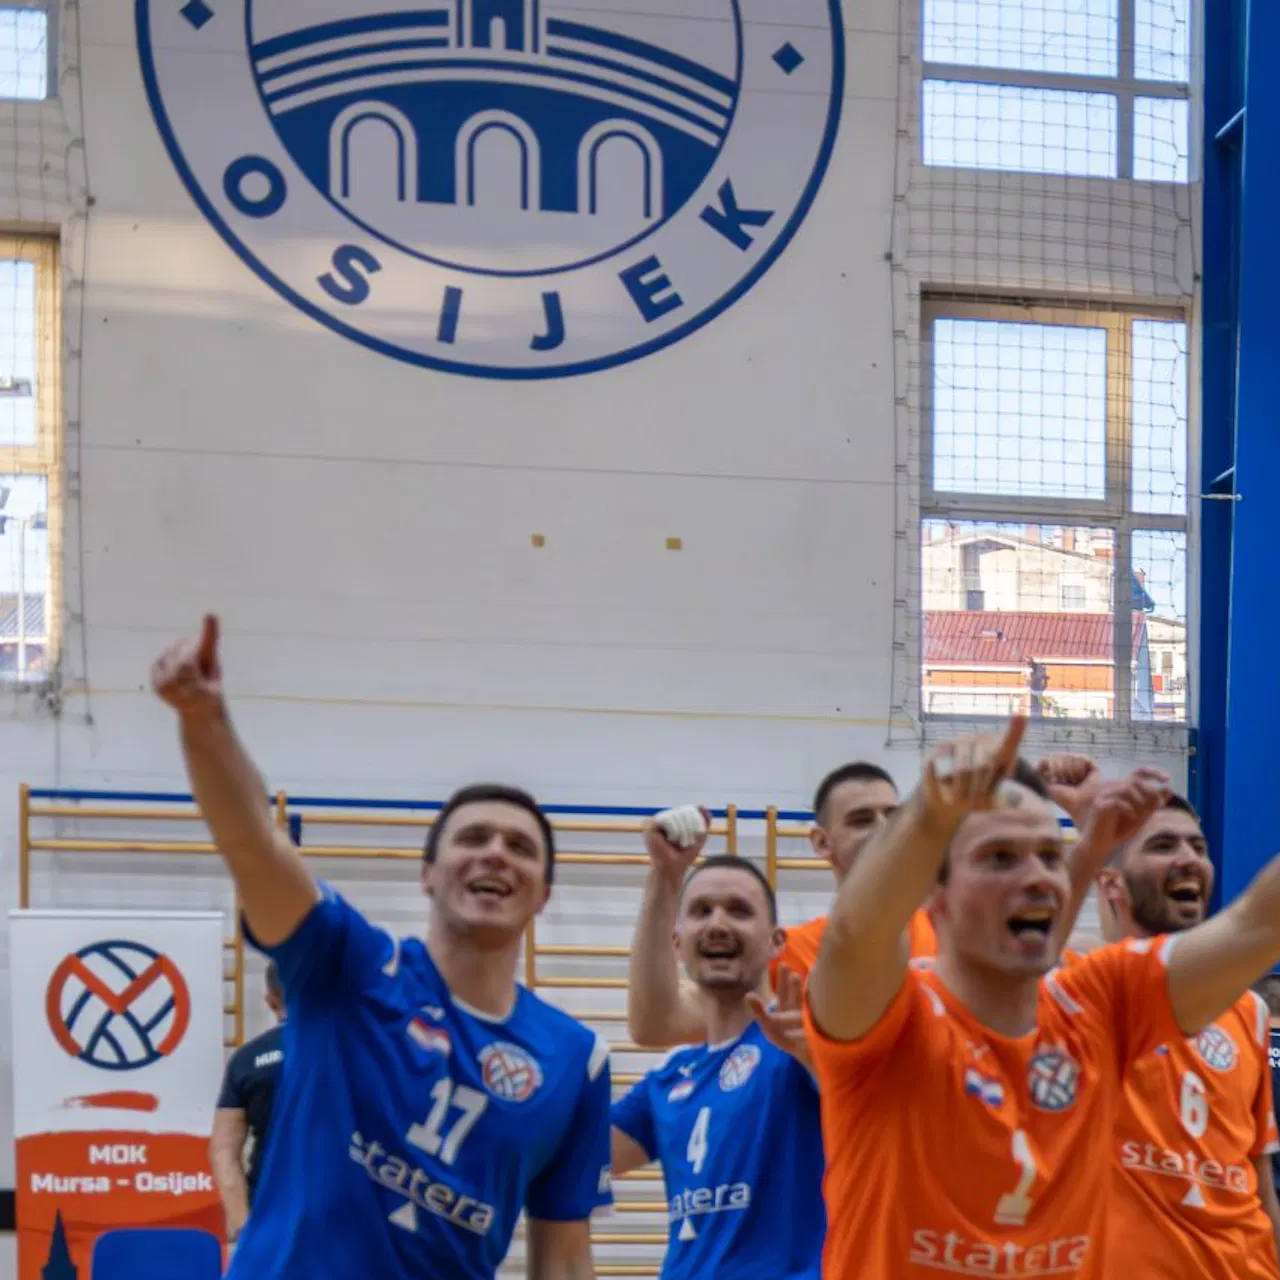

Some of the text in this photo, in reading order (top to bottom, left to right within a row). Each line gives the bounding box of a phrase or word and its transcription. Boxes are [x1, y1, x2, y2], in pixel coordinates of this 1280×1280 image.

[222, 155, 775, 351] OSIJEK
[405, 1076, 490, 1166] 17
[1181, 1070, 1209, 1139] 6
[89, 1144, 147, 1165] MOK
[686, 1106, 711, 1175] 4
[30, 1172, 111, 1194] Mursa
[135, 1170, 213, 1195] Osijek
[911, 1228, 1092, 1274] statera
